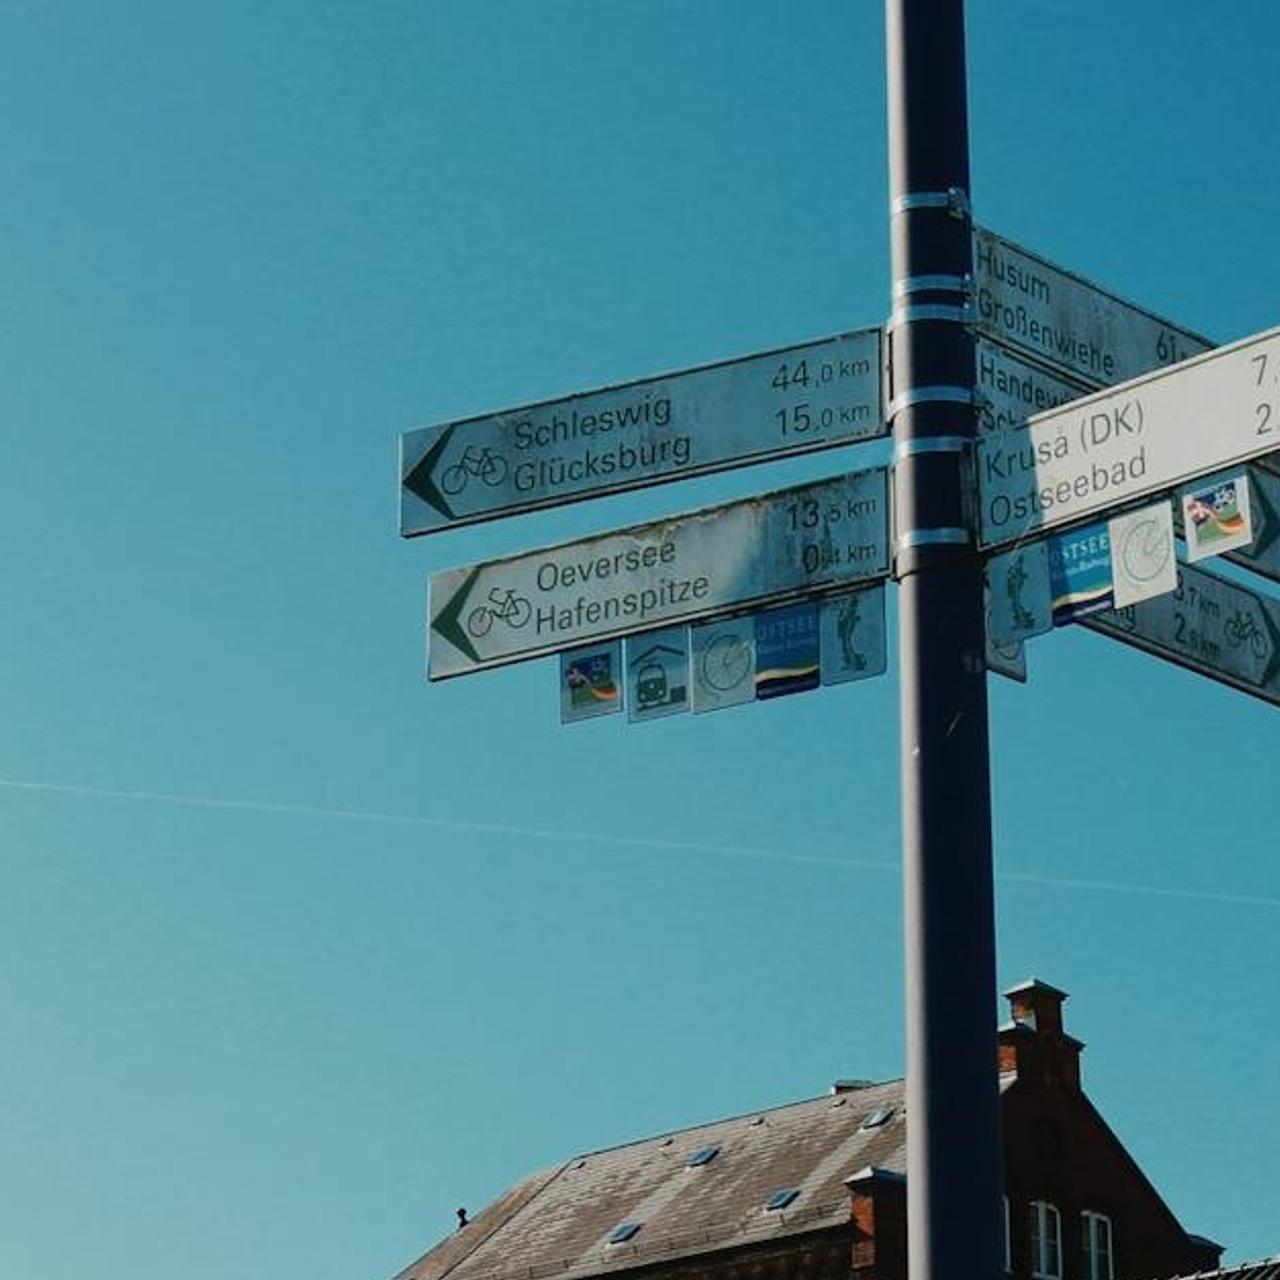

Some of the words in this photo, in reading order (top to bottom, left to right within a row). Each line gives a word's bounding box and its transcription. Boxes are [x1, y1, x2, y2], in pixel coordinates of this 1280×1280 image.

[976, 240, 1050, 304] Husum
[771, 359, 833, 392] 44,0
[839, 358, 869, 378] km
[514, 394, 671, 451] Schleswig
[775, 403, 833, 436] 15,0
[839, 404, 870, 424] km
[1080, 399, 1144, 453] (DK)
[514, 436, 691, 492] Glücksburg
[989, 446, 1147, 527] Ostseebad
[847, 499, 877, 519] km
[536, 541, 677, 592] Oeversee
[847, 541, 877, 563] km
[536, 576, 710, 635] Hafenspitze
